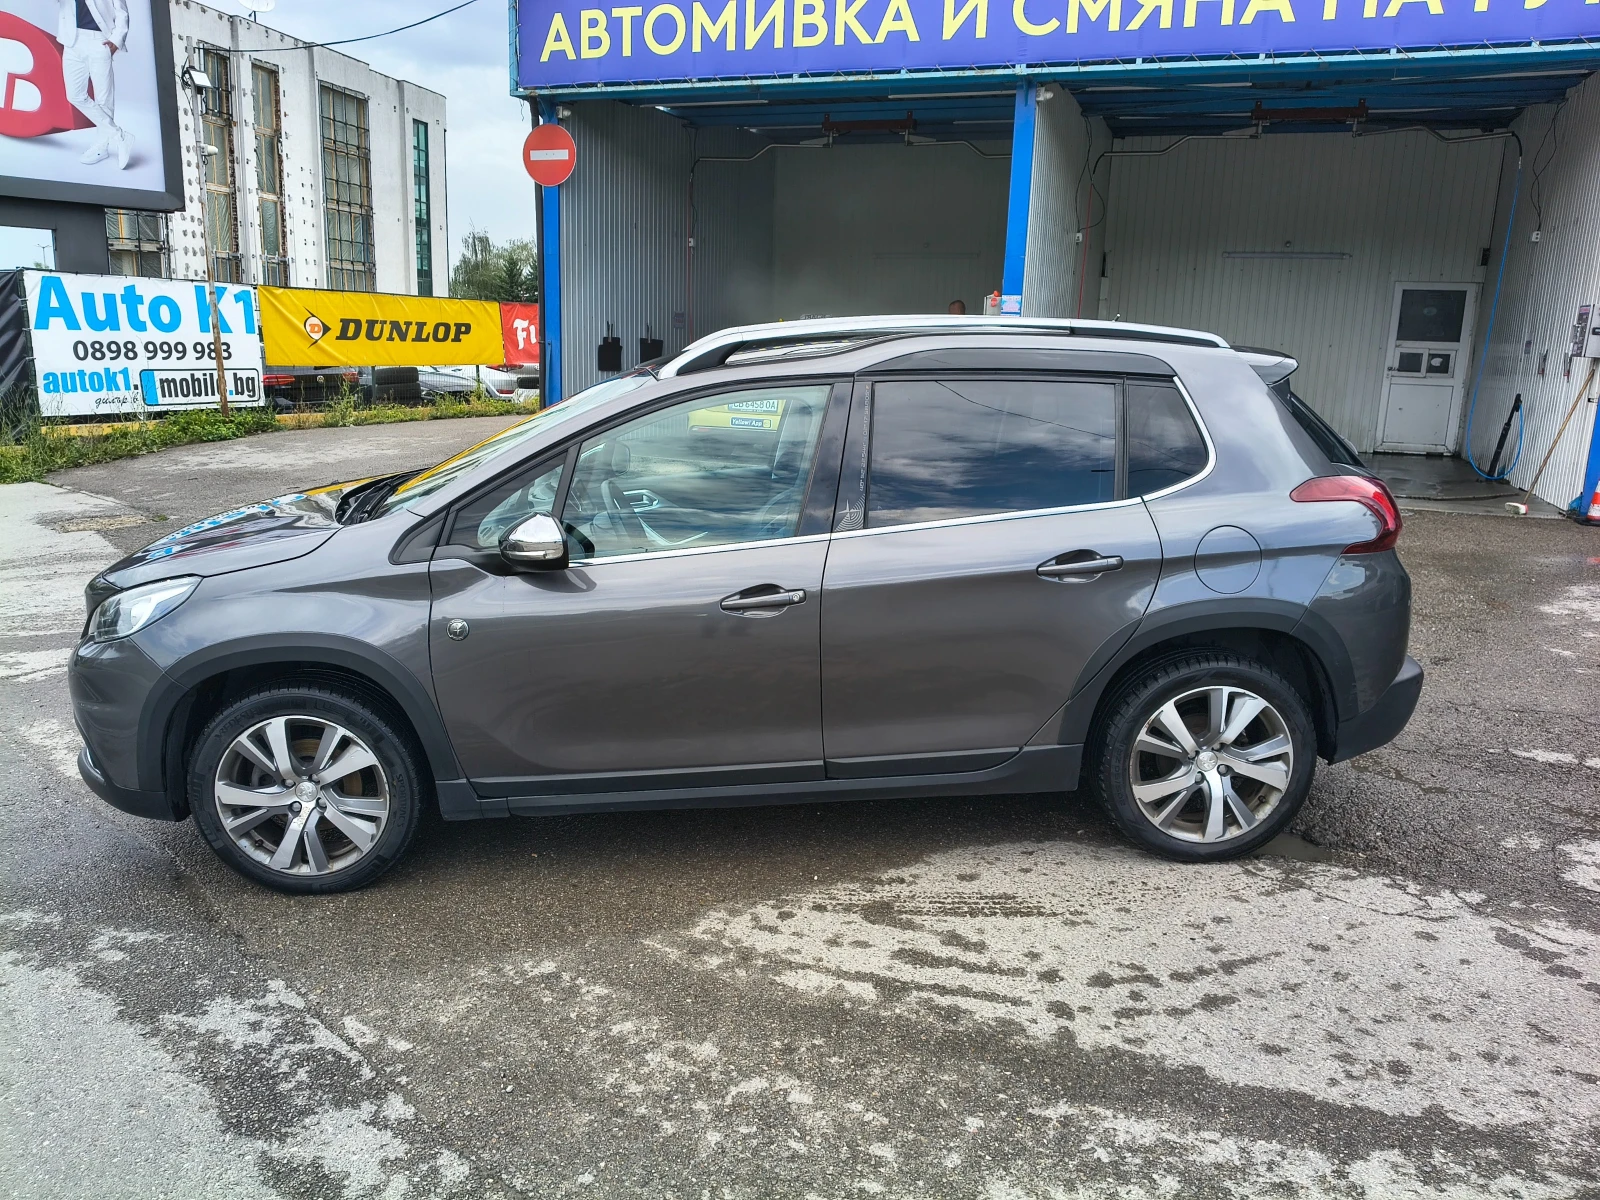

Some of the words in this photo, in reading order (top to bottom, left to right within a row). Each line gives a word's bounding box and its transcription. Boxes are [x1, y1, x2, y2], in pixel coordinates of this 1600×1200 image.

[539, 0, 921, 62] АВТОМИВКА
[942, 0, 989, 41] И
[34, 276, 182, 333] Auto
[194, 285, 256, 334] K1
[73, 340, 138, 361] 0898
[143, 341, 187, 361] 999
[193, 341, 233, 361] 983
[335, 317, 472, 343] DUNLOP
